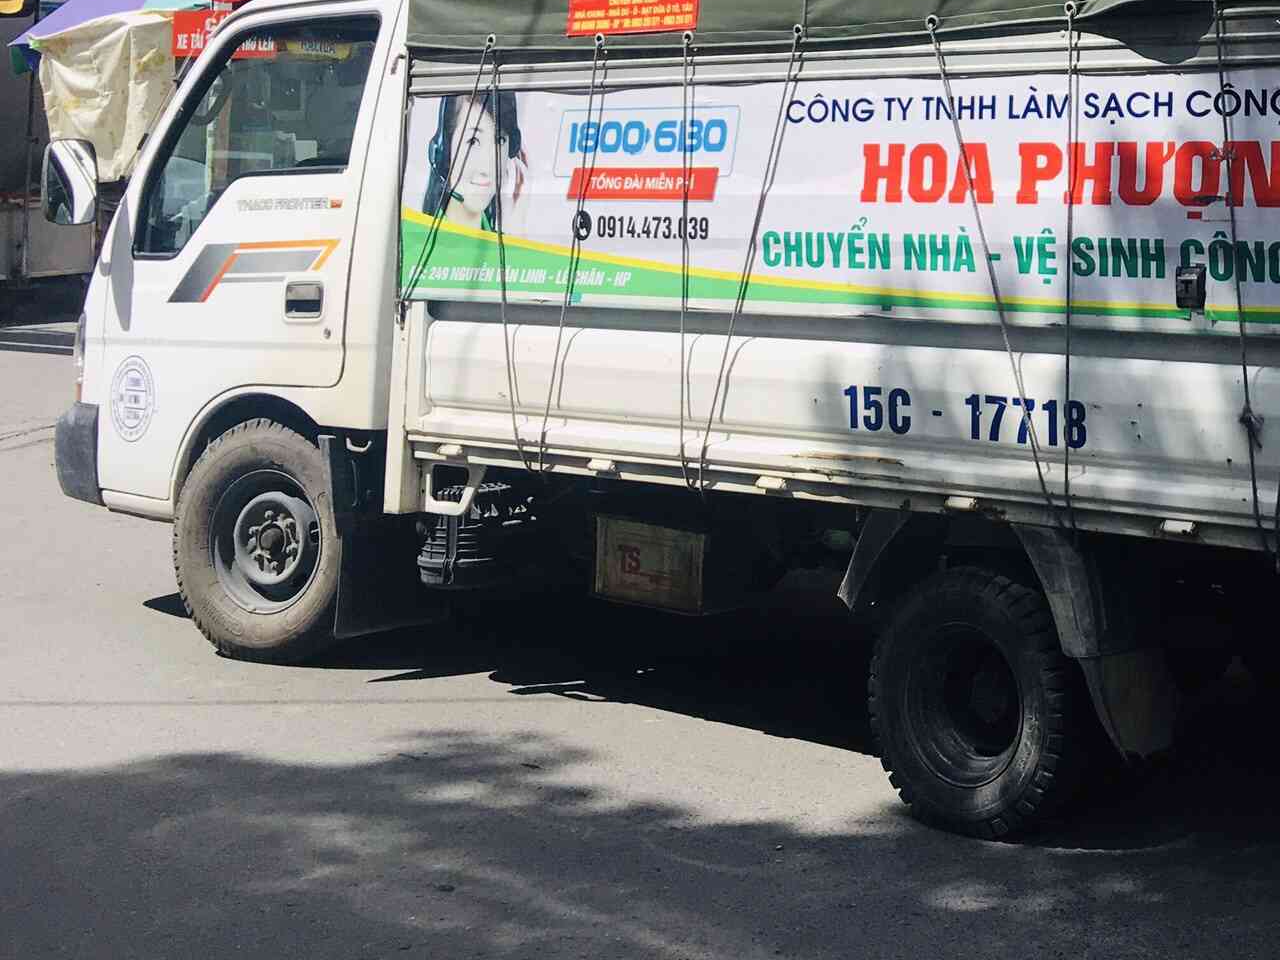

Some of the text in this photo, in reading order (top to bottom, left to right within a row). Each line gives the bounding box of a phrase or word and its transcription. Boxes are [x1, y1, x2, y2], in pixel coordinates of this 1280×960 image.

[177, 33, 189, 49] XE
[786, 93, 875, 124] CÔNG
[883, 96, 914, 121] TY
[922, 95, 996, 121] TNHH
[1008, 86, 1070, 120] LÀM
[1084, 90, 1174, 125] SẠCH
[623, 173, 644, 190] ĐÀI
[676, 173, 695, 190] PÍ
[860, 141, 994, 205] HOA
[762, 216, 891, 270] CHUYỂN
[903, 226, 977, 273] NHÀ
[1013, 227, 1058, 285] VỆ
[1072, 236, 1167, 279] SINH
[843, 385, 911, 435] 15C
[964, 393, 1087, 449] 17718
